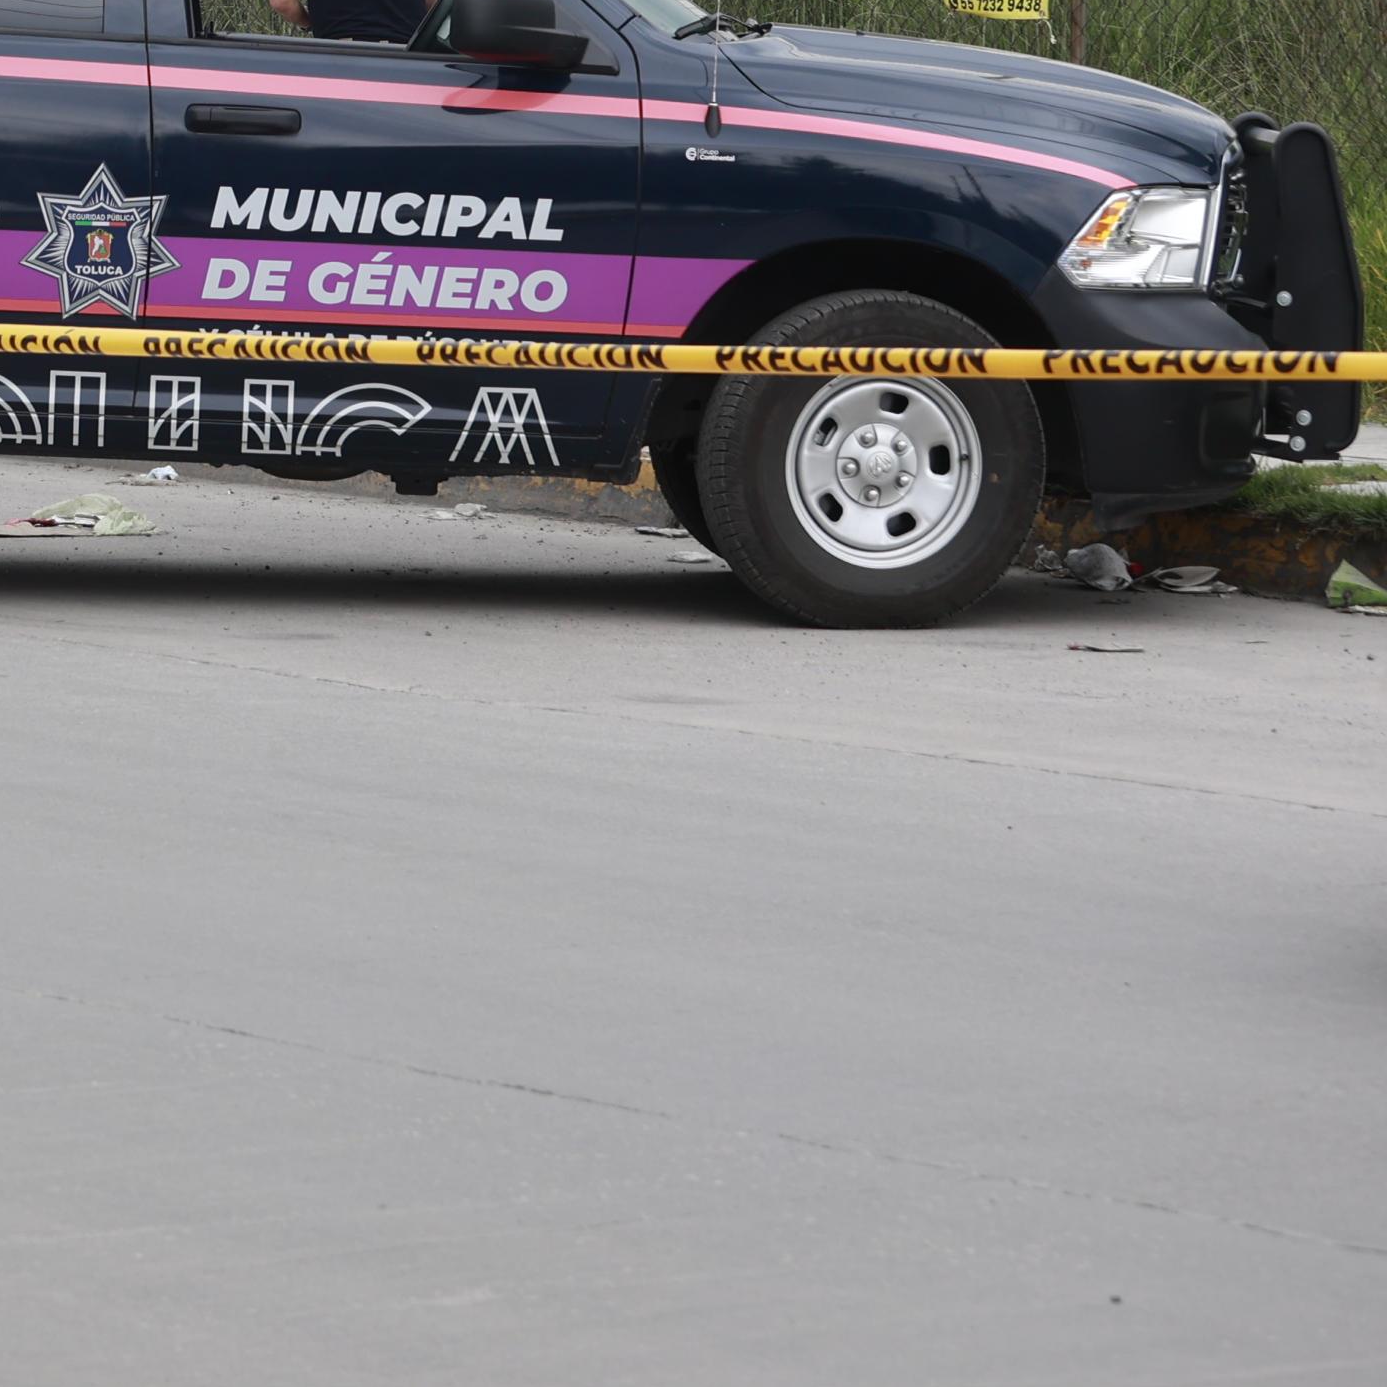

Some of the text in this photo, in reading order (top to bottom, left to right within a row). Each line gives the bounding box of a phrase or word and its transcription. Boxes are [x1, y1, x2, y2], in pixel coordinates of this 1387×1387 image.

[699, 148, 720, 156] Grupo
[699, 154, 736, 162] Continental
[106, 213, 135, 221] PÚBLICA
[210, 186, 564, 241] MUNICIPAL
[75, 265, 123, 275] TOLUCA
[201, 252, 568, 312] DE GÉNERO
